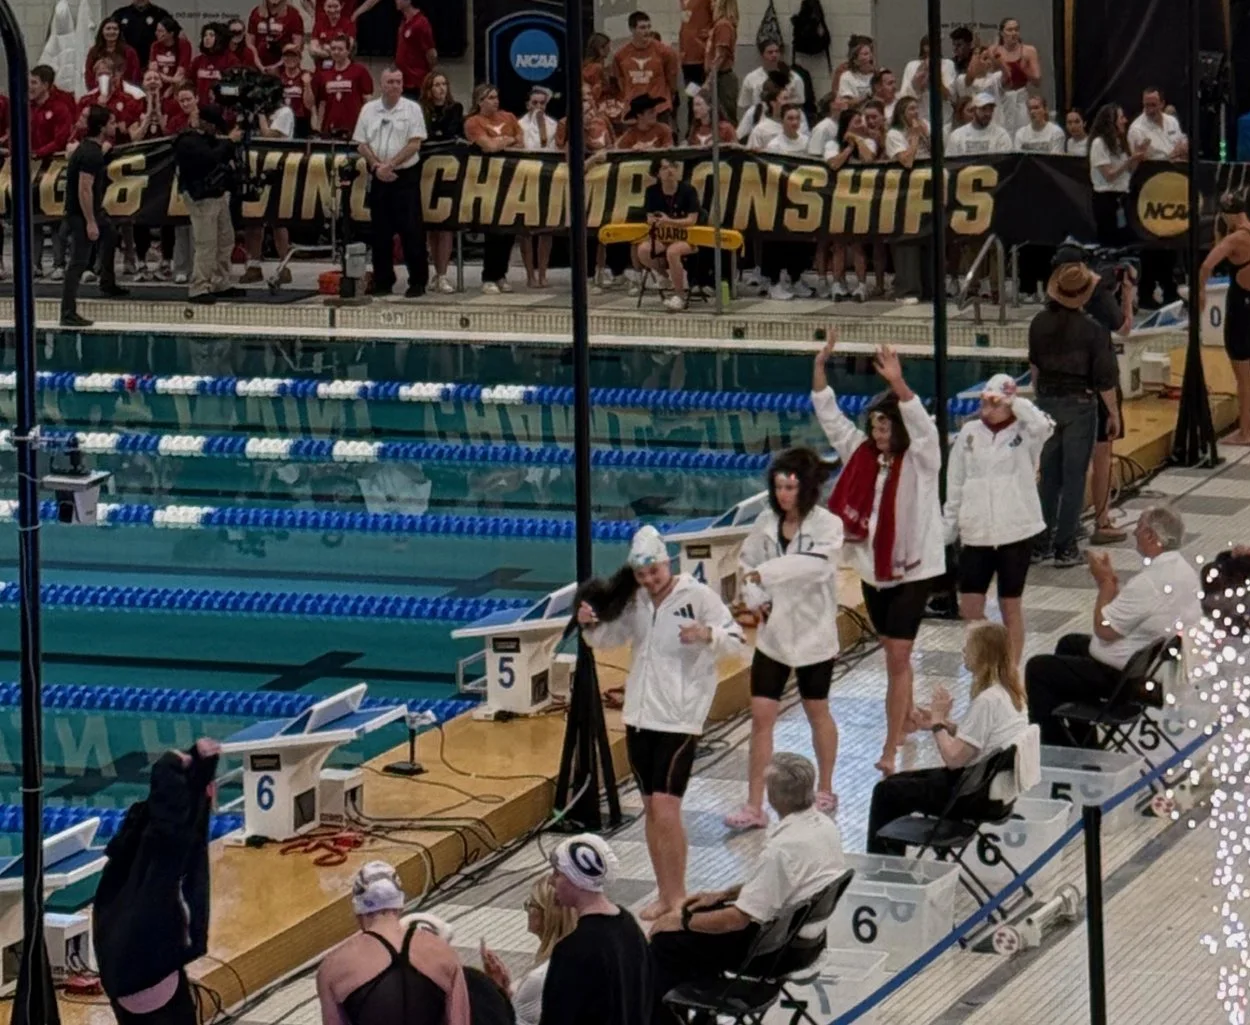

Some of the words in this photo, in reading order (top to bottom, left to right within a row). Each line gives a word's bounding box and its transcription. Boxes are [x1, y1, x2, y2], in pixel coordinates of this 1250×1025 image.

[515, 54, 558, 68] NCAA
[103, 154, 149, 215] &
[420, 155, 998, 235] CHAMPONSHIPS
[1210, 306, 1221, 327] 0
[498, 656, 514, 689] 5
[1138, 720, 1161, 751] 5
[256, 775, 275, 811] 6
[976, 833, 1001, 866] 6
[852, 905, 878, 943] 6
